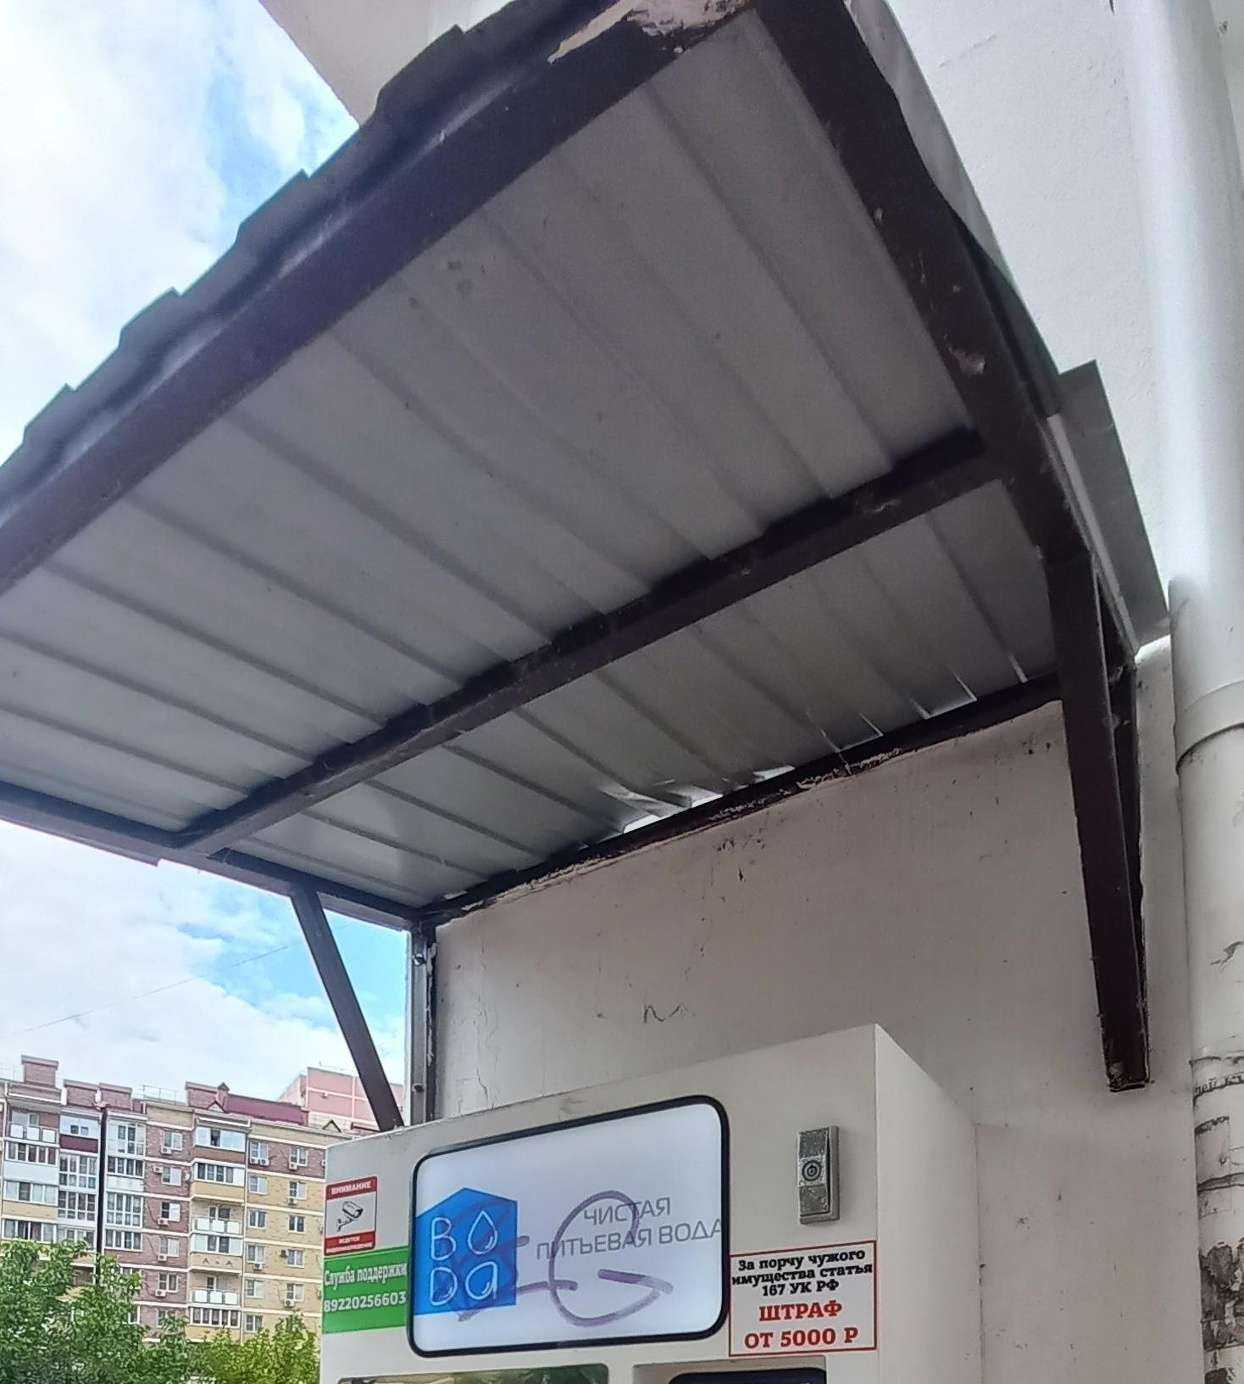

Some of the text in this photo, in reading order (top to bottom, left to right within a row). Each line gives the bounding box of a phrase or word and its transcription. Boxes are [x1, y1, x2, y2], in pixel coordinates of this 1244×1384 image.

[584, 1197, 671, 1225] ЧИСТАЯ
[536, 1229, 652, 1260] ПИТЬЕВАЯ
[738, 1249, 866, 1271] За порчу чужого
[324, 1262, 408, 1290] Служба поддержки
[731, 1263, 873, 1287] имущества статья
[762, 1278, 840, 1296] 167 УК РФ
[324, 1291, 407, 1313] 89220256603
[759, 1300, 842, 1321] ШТРАФ
[744, 1327, 859, 1348] ОТ 5000 Р
